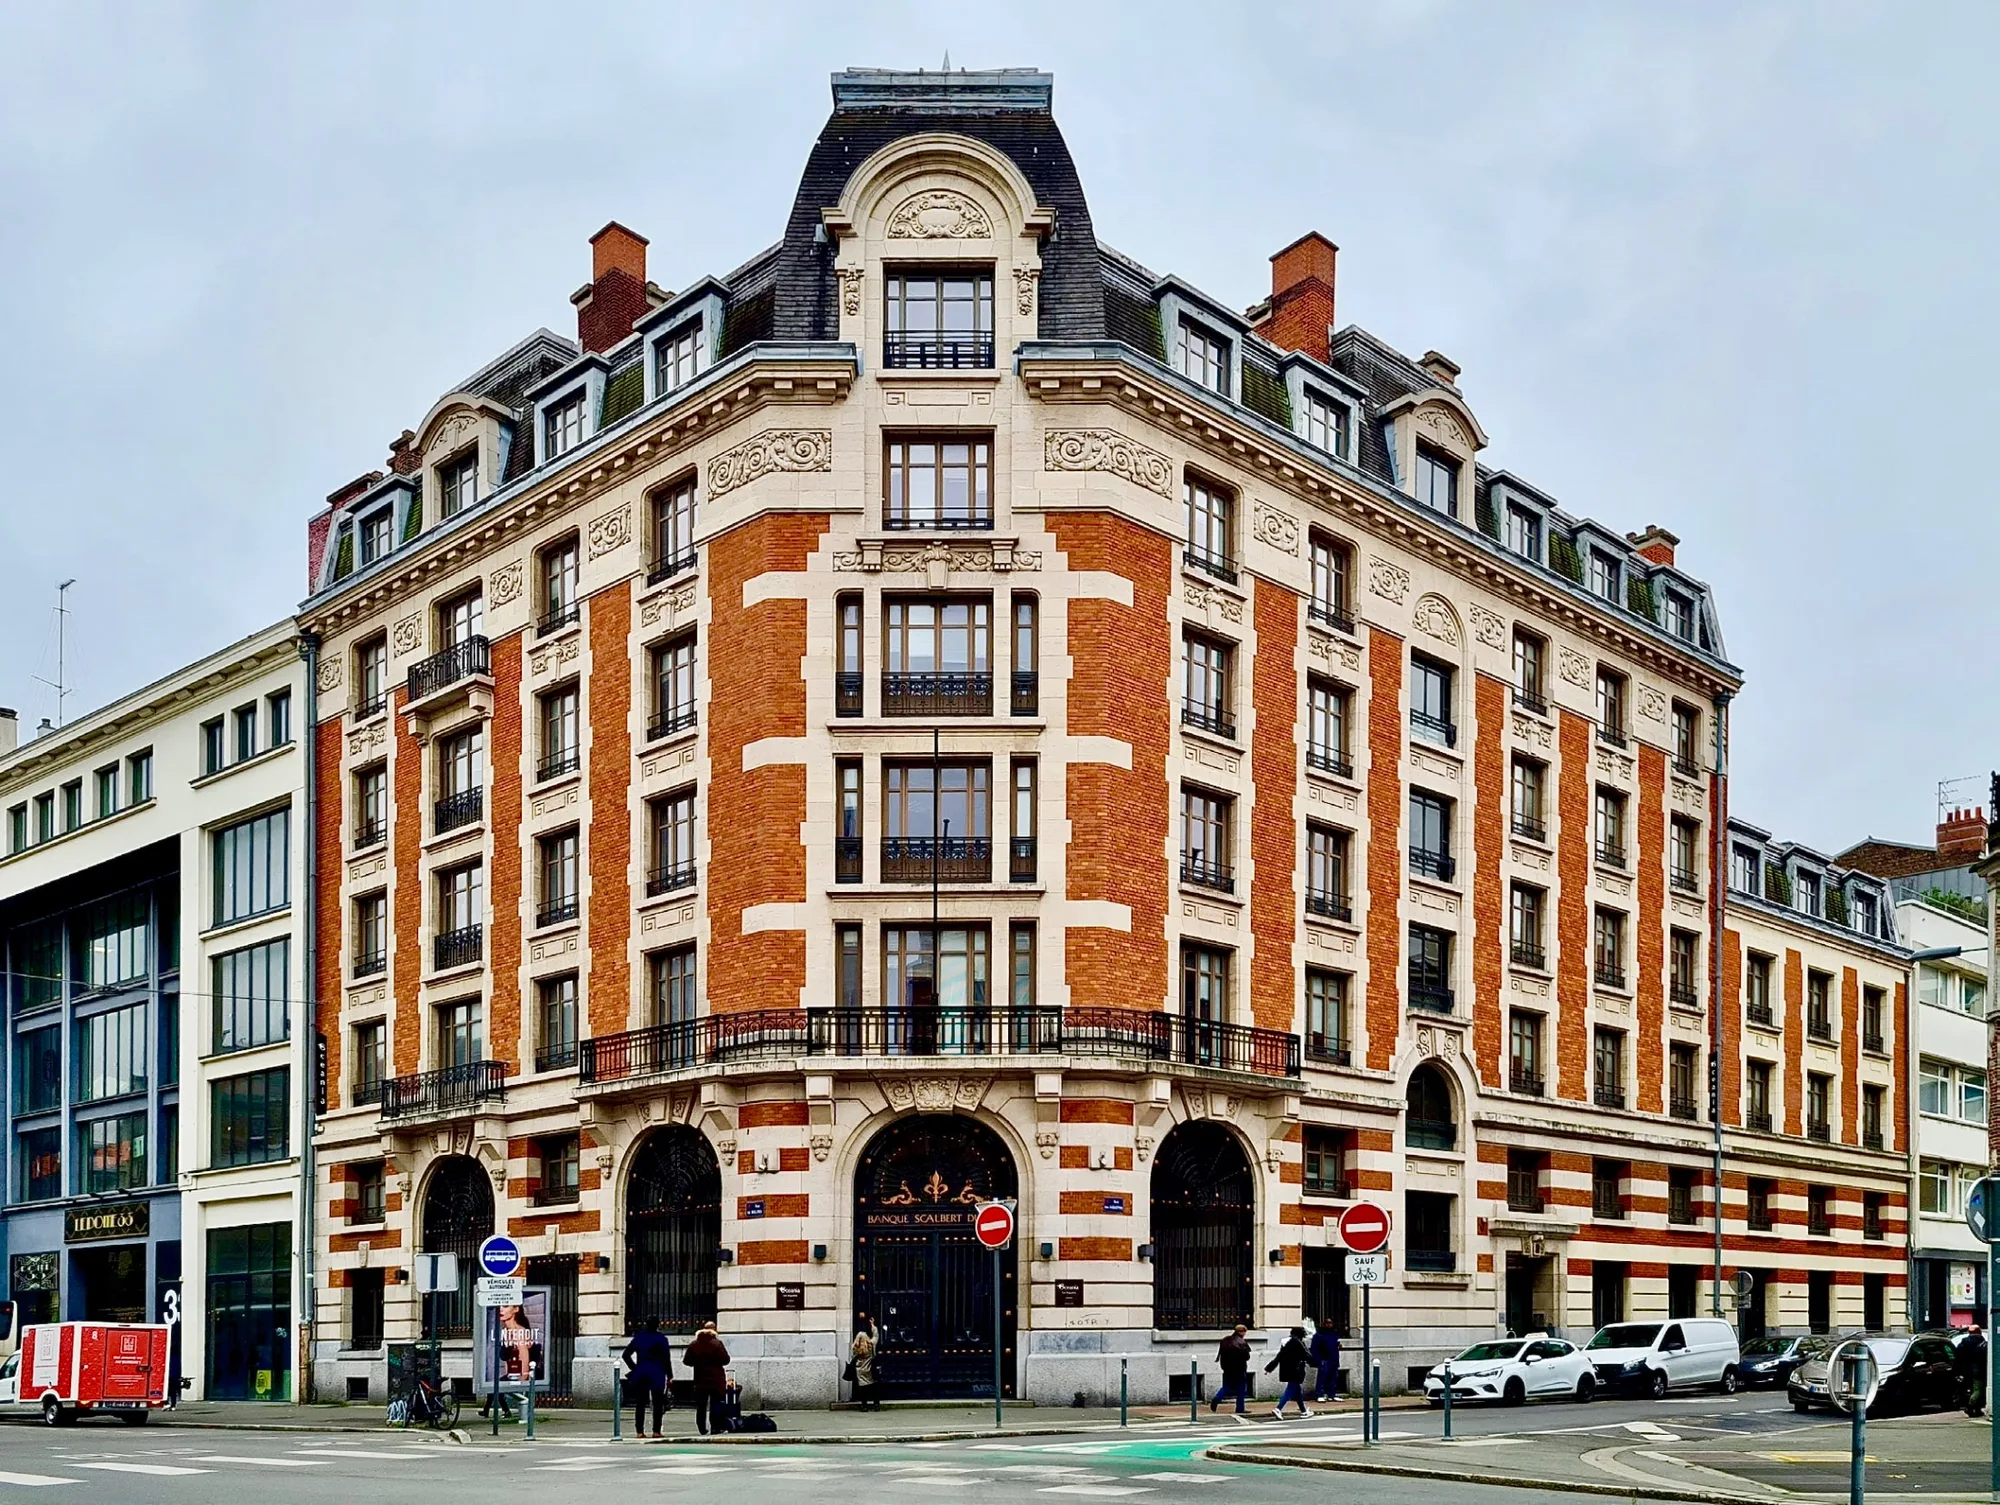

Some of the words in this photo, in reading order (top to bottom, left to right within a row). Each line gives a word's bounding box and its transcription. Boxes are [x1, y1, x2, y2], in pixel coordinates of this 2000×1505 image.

[867, 1214, 909, 1224] BANQUE
[914, 1213, 963, 1223] SCALBERT
[967, 1213, 977, 1222] D
[1354, 1257, 1375, 1265] SAUF
[490, 1328, 540, 1341] LNTERDIT
